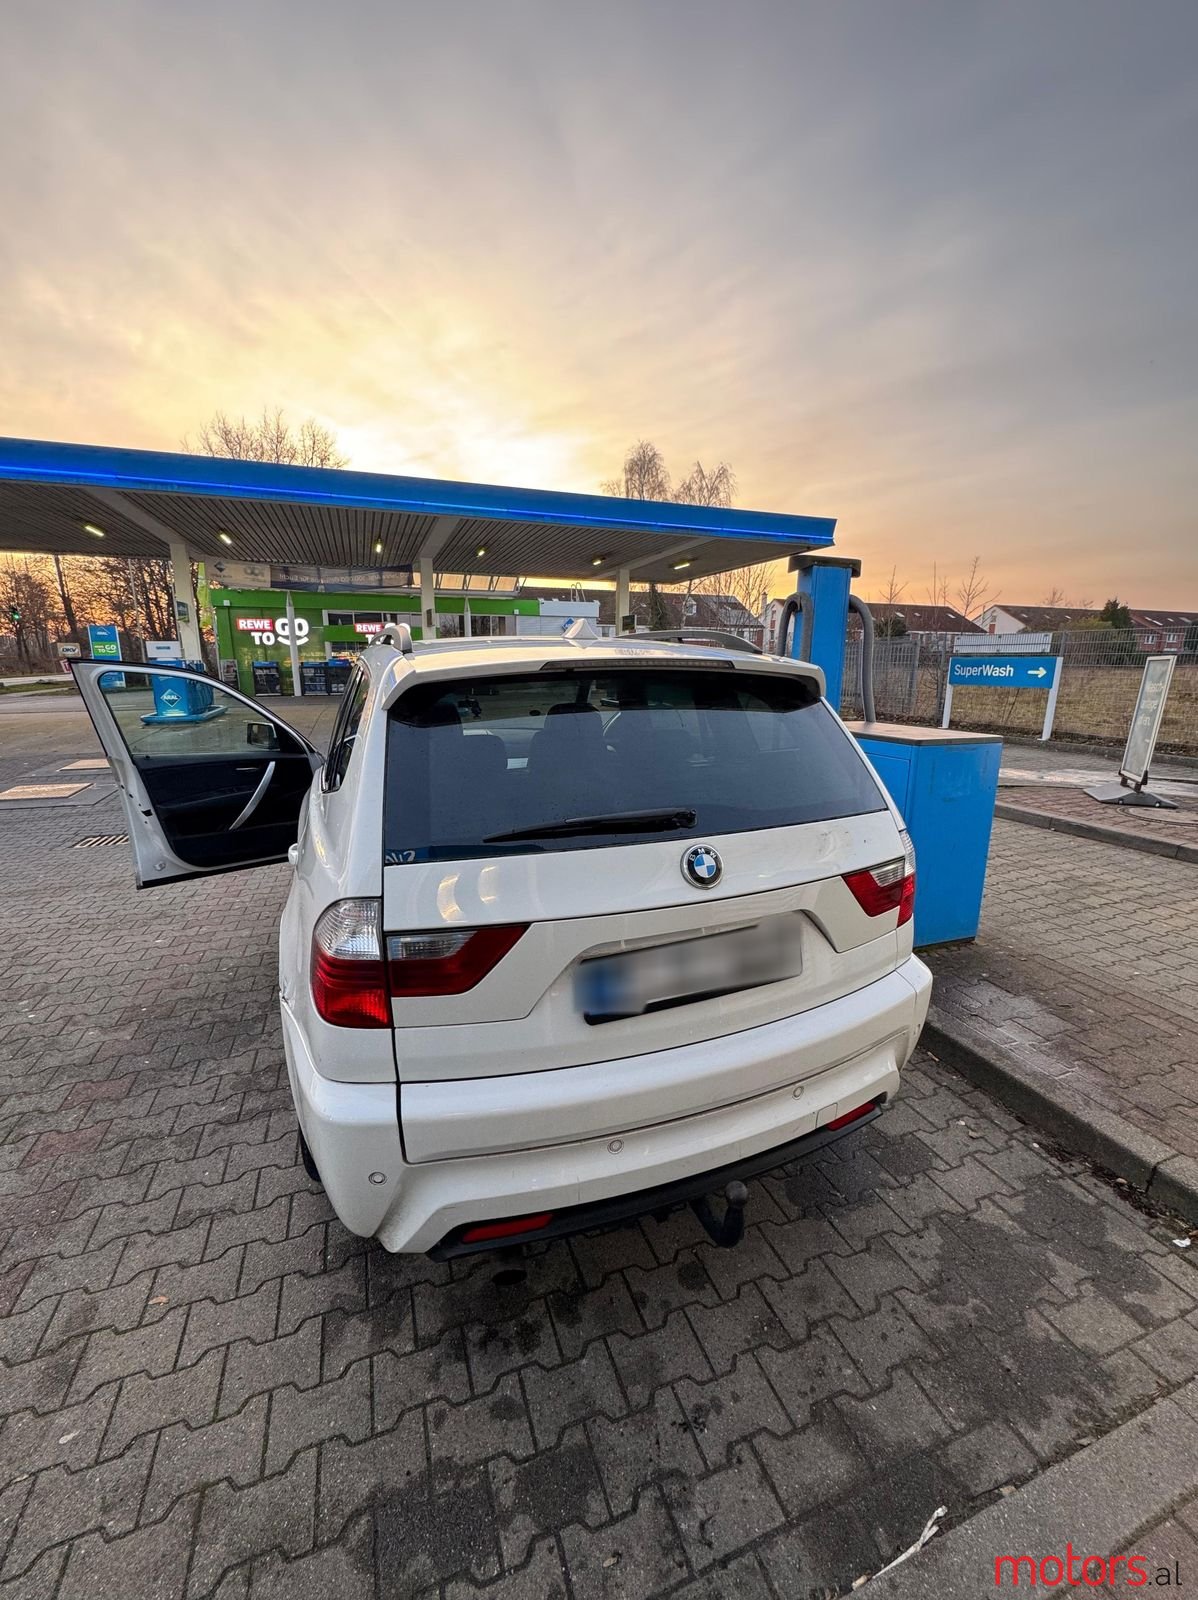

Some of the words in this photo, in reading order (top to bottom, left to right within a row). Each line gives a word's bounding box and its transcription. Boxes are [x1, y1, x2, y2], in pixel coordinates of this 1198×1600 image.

[239, 619, 271, 630] REWE
[355, 623, 382, 633] REWE
[251, 632, 275, 646] TO
[954, 664, 1014, 678] SuperWash
[689, 848, 717, 861] BMW
